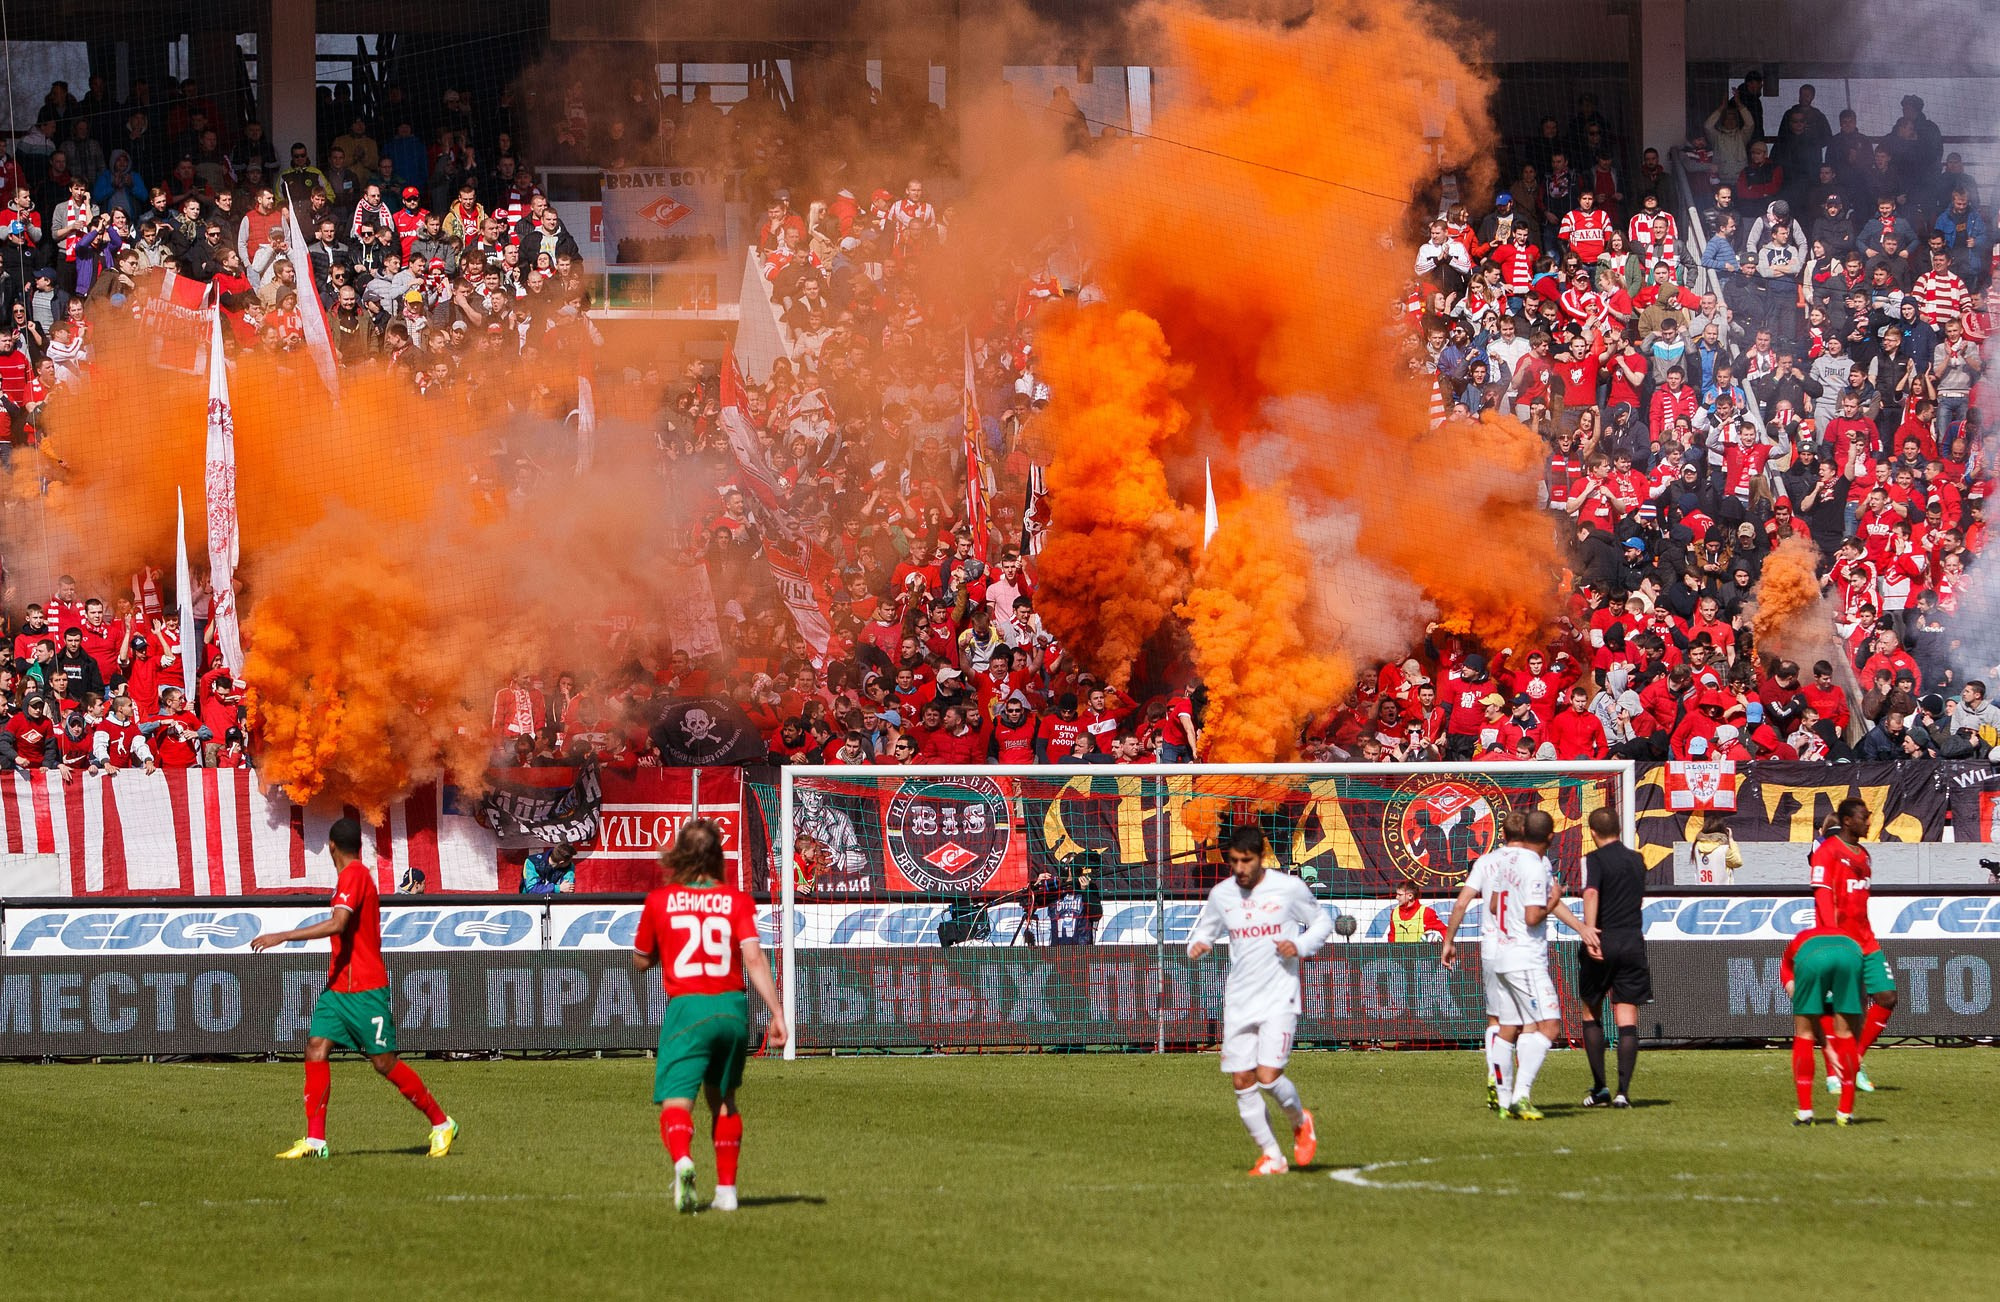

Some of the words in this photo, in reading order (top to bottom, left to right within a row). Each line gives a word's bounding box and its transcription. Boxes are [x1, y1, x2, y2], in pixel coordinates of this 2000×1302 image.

[606, 172, 666, 189] BRAVE
[1054, 724, 1078, 732] КРЫМ
[911, 803, 986, 836] BIS
[1388, 812, 1400, 842] ONE
[1417, 773, 1441, 790] ALL
[1481, 783, 1503, 811] FOR
[896, 852, 935, 890] BELIEF
[955, 847, 1003, 892] SPARTAK
[1396, 848, 1432, 886] THE
[1700, 870, 1713, 883] 36
[666, 893, 733, 915] ДЕНИСОВ
[10, 912, 263, 951] FESCO
[284, 909, 534, 949] FSCO
[670, 914, 732, 978] 29
[275, 967, 450, 1042] ДЯ
[1088, 958, 1463, 1021] ПОКПОК
[371, 1016, 384, 1041] 7
